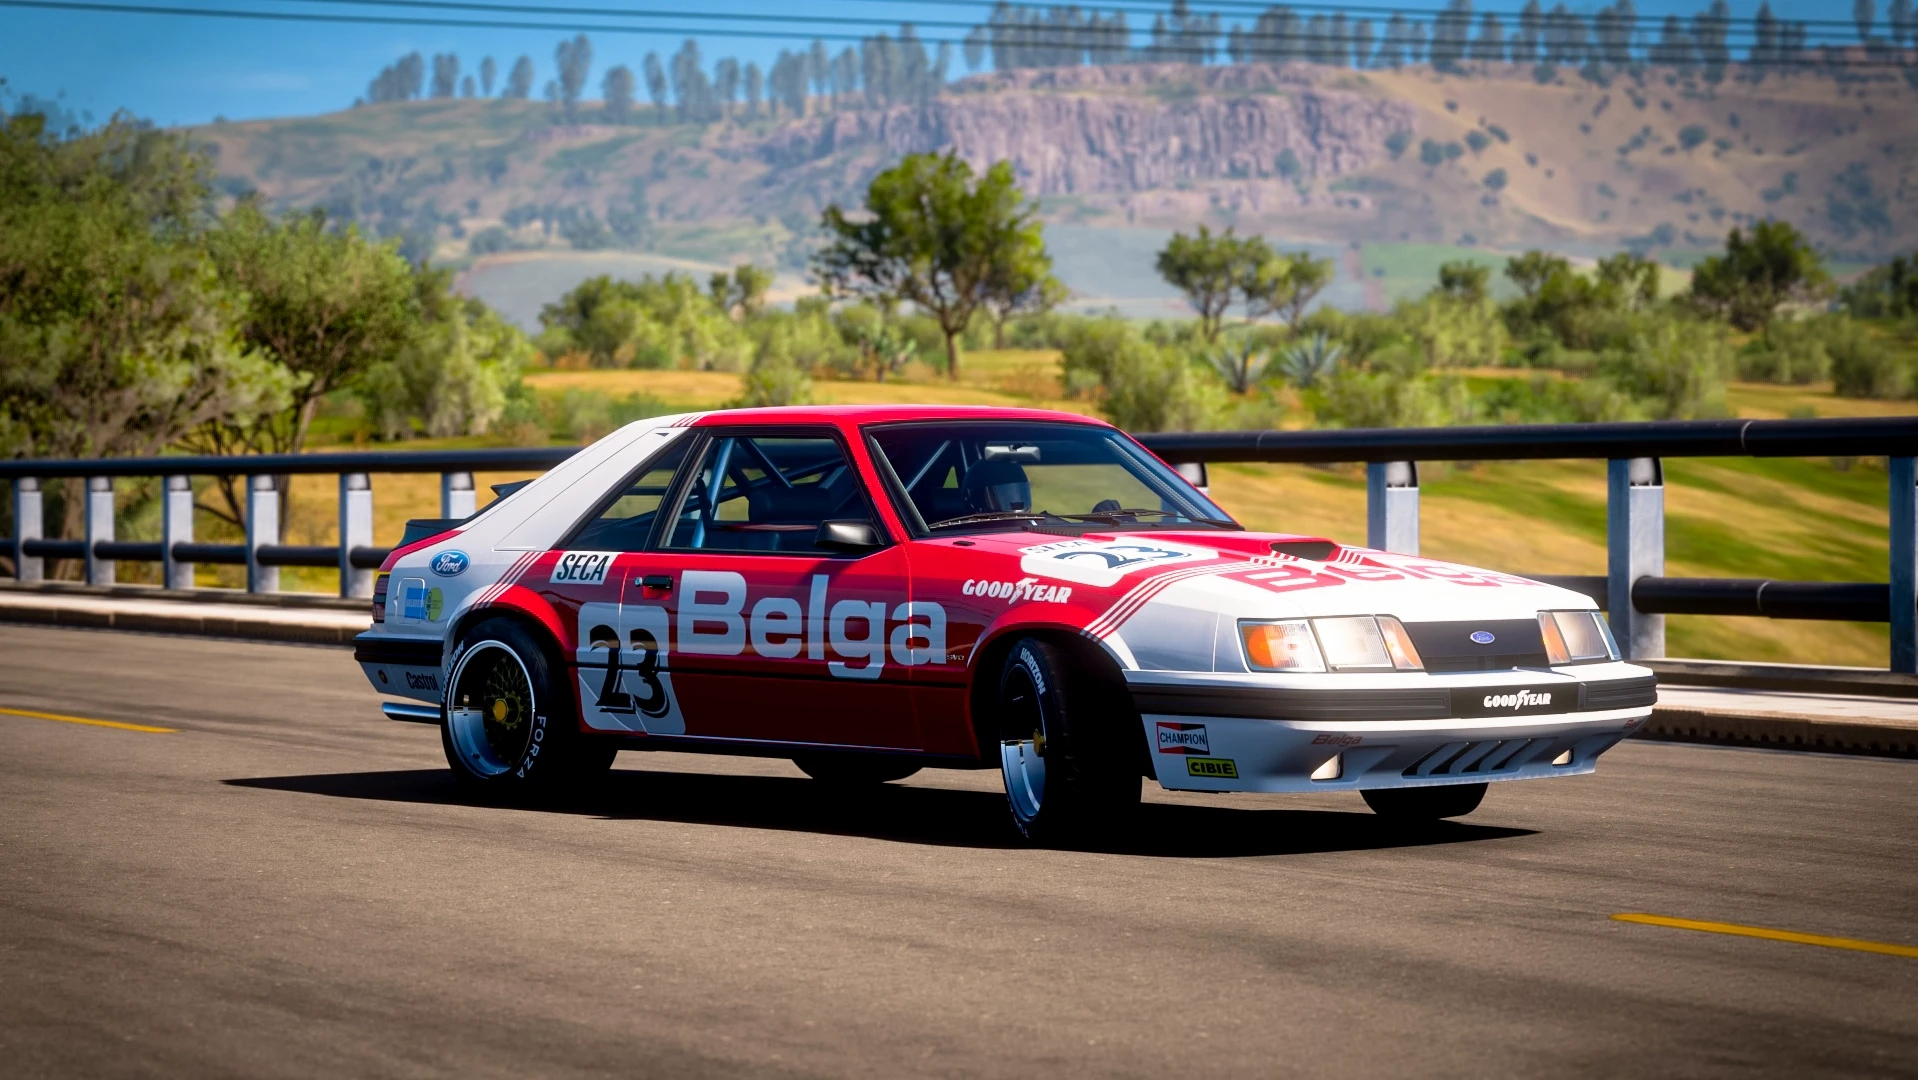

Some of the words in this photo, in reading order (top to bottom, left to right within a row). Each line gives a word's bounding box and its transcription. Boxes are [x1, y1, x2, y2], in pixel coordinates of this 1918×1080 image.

[436, 554, 461, 573] Ford
[556, 554, 608, 581] SECA
[1052, 545, 1192, 570] 23
[1213, 558, 1547, 593] Belga
[962, 578, 1072, 605] GOODYEAR
[677, 570, 947, 679] Belga
[406, 671, 440, 691] Castrol
[589, 624, 671, 718] 23
[1020, 647, 1047, 696] HORIZON
[1483, 689, 1551, 711] GOODYEAR
[516, 715, 547, 778] FORZA
[1159, 730, 1206, 746] CHAMPION
[1311, 733, 1363, 748] Belga
[1191, 759, 1235, 775] CIBIE
